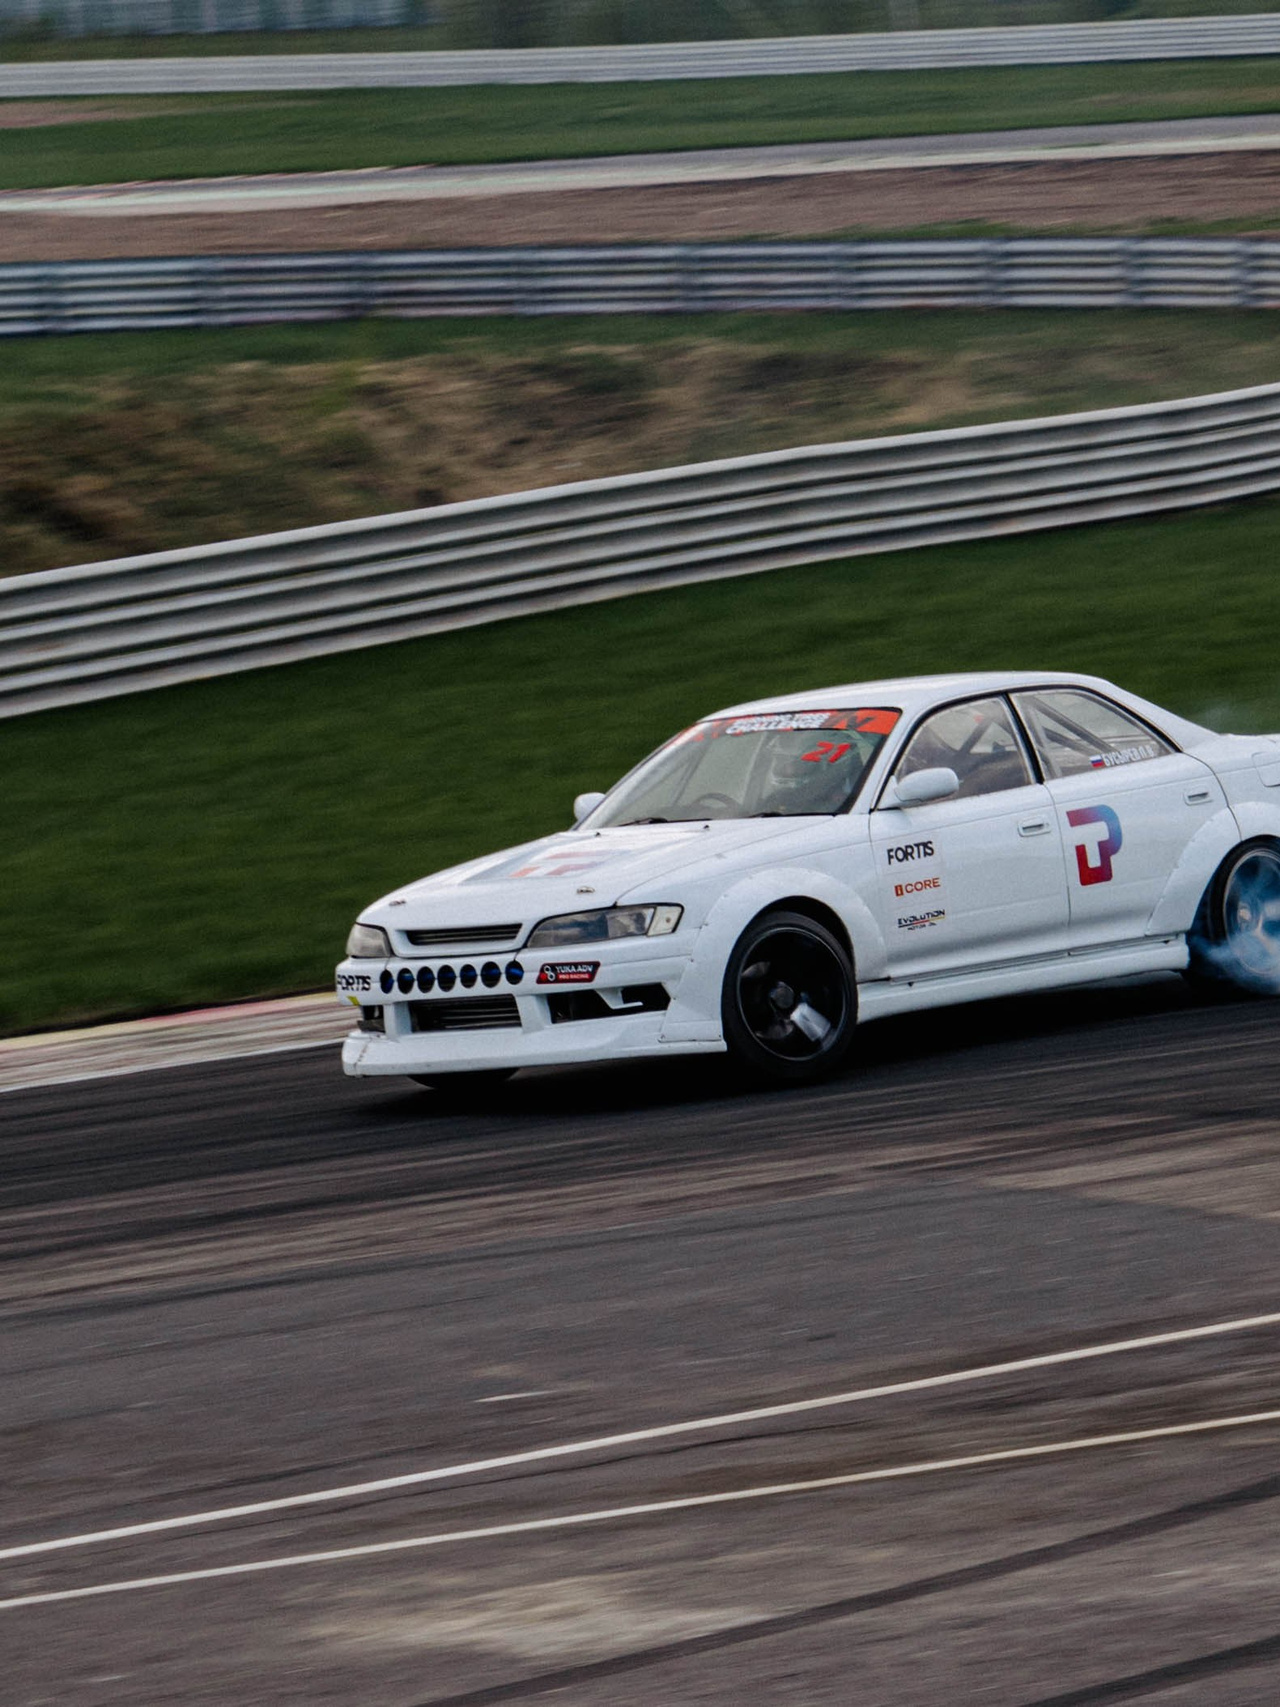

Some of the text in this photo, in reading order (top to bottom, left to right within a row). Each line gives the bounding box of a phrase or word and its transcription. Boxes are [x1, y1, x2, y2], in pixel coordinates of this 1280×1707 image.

[801, 741, 851, 764] 21
[887, 841, 934, 865] FORTIS
[897, 909, 946, 925] EVOLUTION
